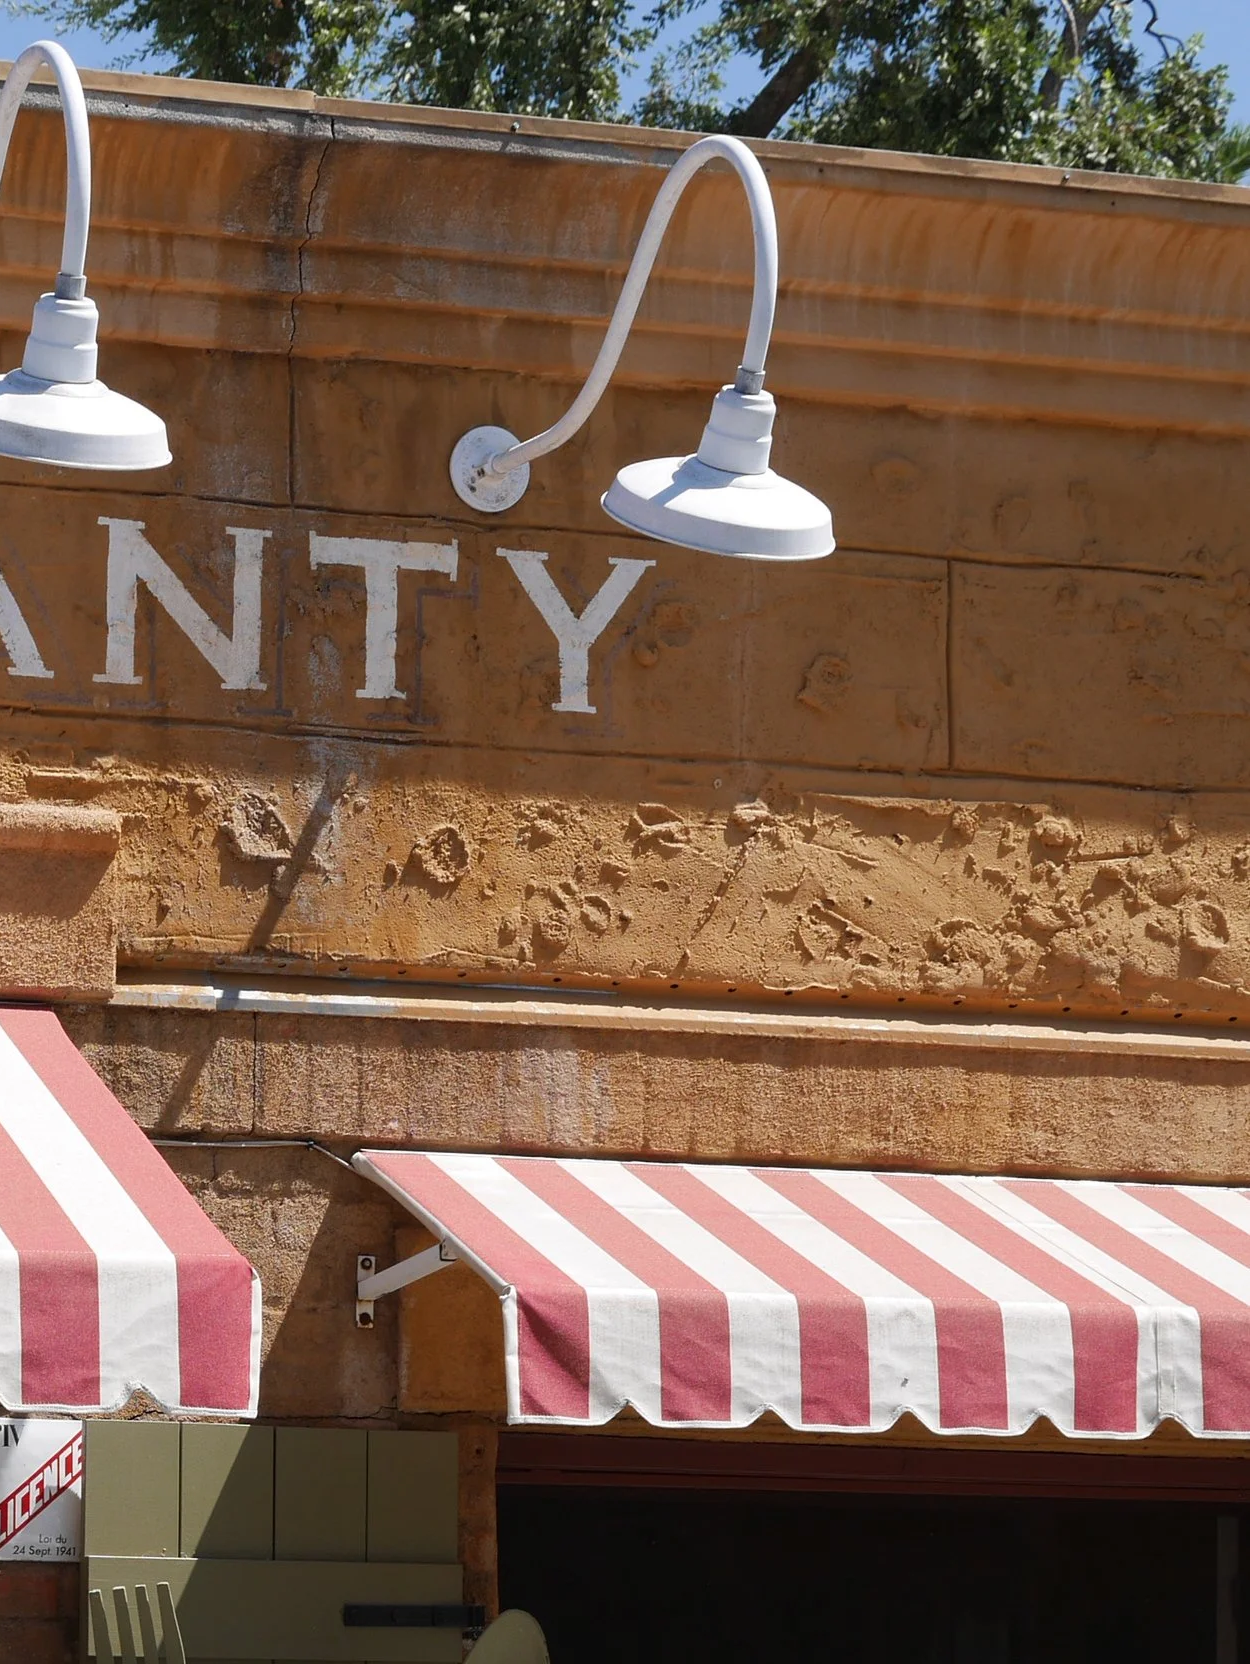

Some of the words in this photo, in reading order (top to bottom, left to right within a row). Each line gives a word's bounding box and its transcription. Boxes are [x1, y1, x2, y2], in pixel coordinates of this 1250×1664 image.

[55, 1533, 67, 1544] du
[13, 1545, 26, 1555] 24
[28, 1545, 52, 1557] Sept.
[55, 1546, 77, 1557] 1941
